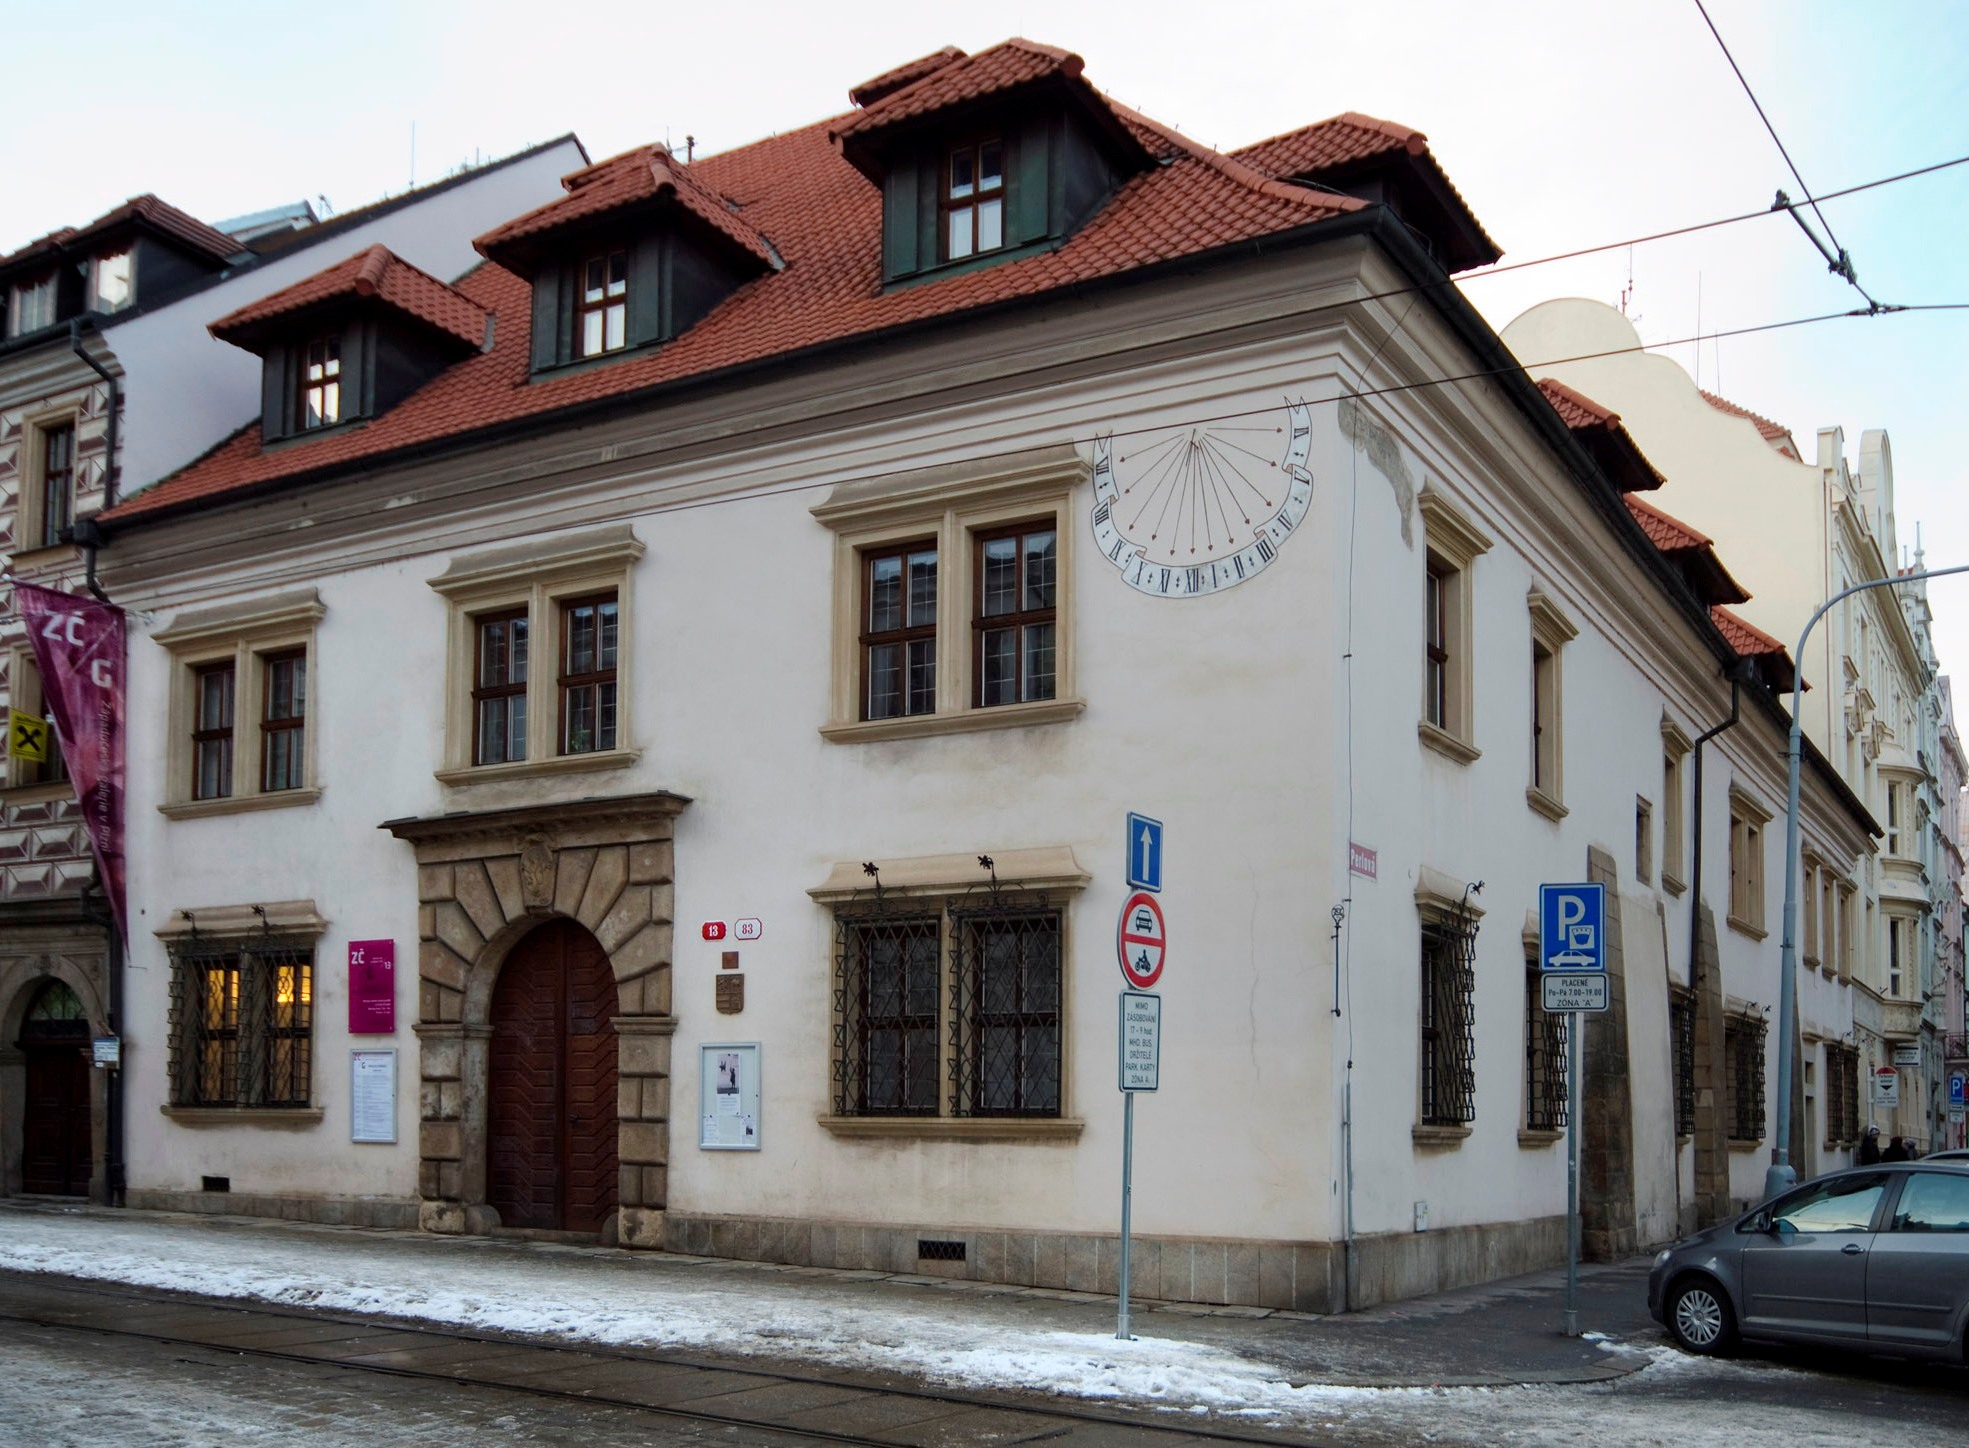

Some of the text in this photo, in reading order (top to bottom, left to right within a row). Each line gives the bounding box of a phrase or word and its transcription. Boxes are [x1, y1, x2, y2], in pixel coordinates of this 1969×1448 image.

[1108, 538, 1127, 562] IX
[1131, 561, 1148, 585] X
[1159, 568, 1171, 593] XI
[1183, 567, 1200, 593] XII
[1211, 564, 1218, 588] I
[1233, 554, 1245, 579] II
[1255, 539, 1274, 563] III
[1277, 508, 1294, 532] IV
[1293, 469, 1310, 486] V
[42, 609, 85, 647] ZČ
[91, 658, 112, 688] G
[96, 775, 112, 812] galerie
[1558, 895, 1586, 941] P
[708, 925, 719, 937] 13
[742, 923, 753, 935] 83
[351, 948, 365, 965] ZČ
[1561, 978, 1589, 987] PLACENÉ
[1557, 998, 1580, 1007] ZÓNA
[1952, 1079, 1960, 1095] P
